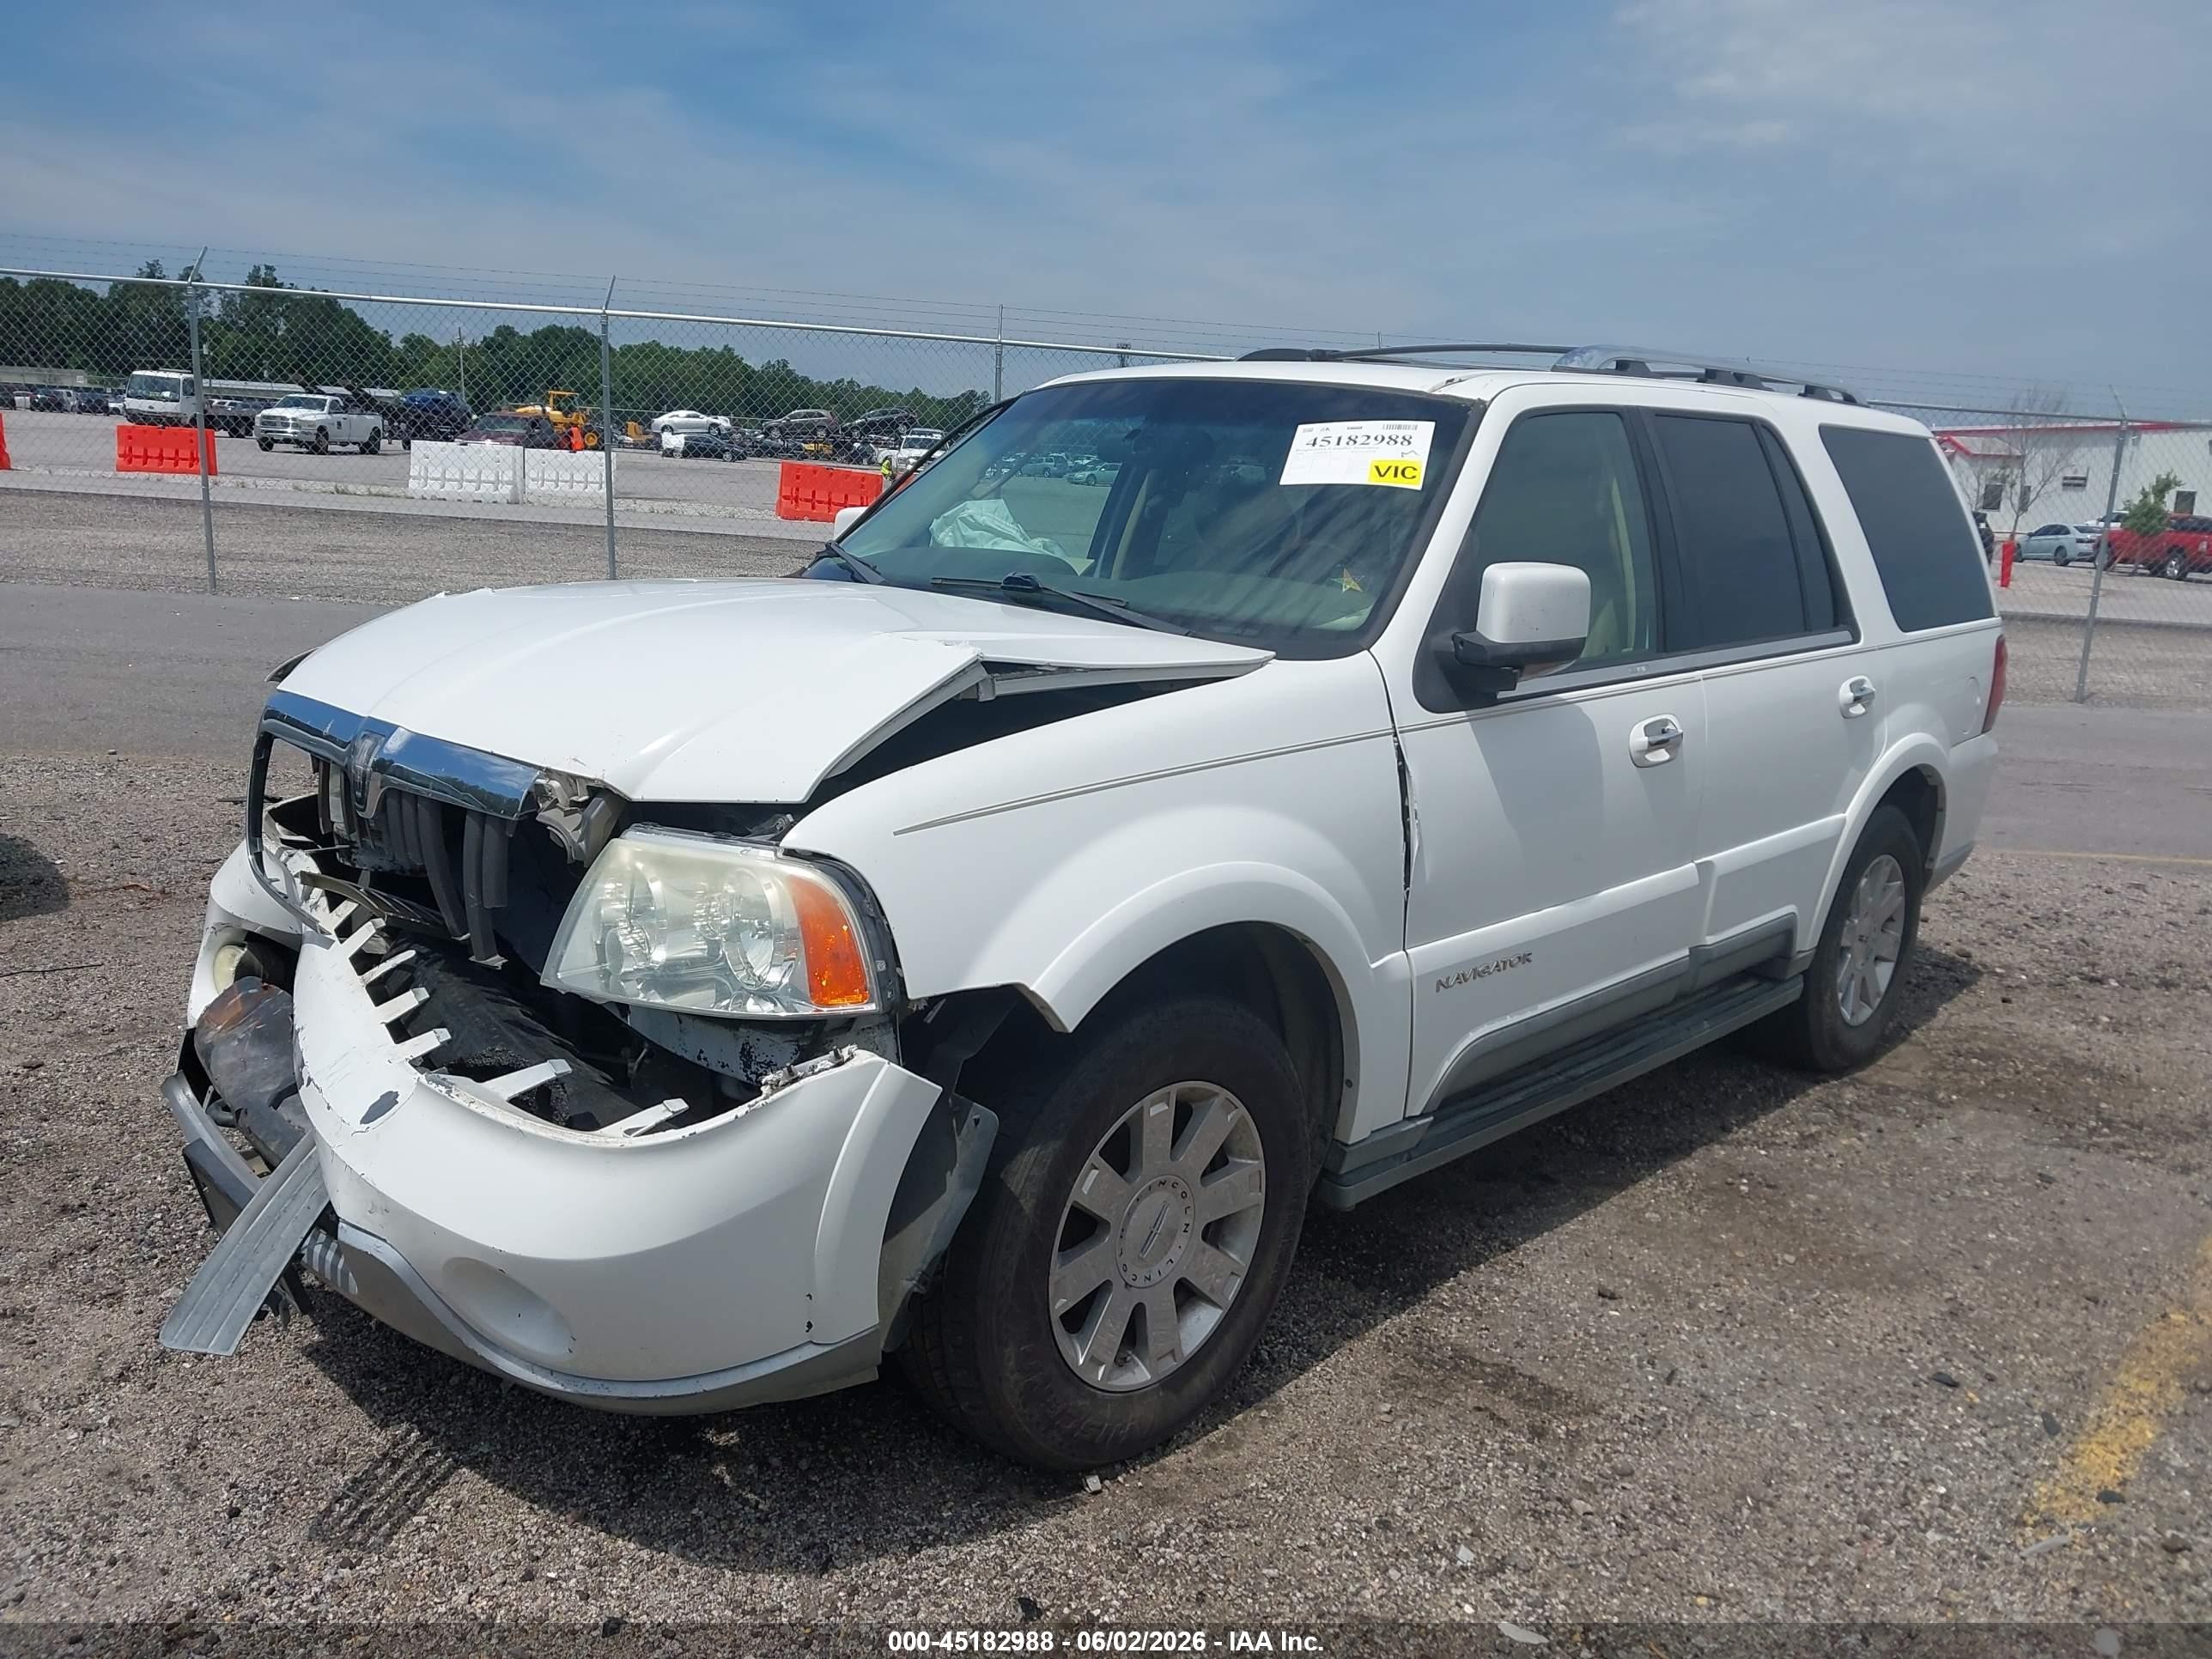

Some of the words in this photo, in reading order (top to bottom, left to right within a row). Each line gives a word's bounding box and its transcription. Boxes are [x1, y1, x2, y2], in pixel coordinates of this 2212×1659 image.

[1305, 434, 1413, 447] 45182988
[1374, 465, 1418, 479] VIC
[1436, 952, 1533, 993] NAVIGATOR
